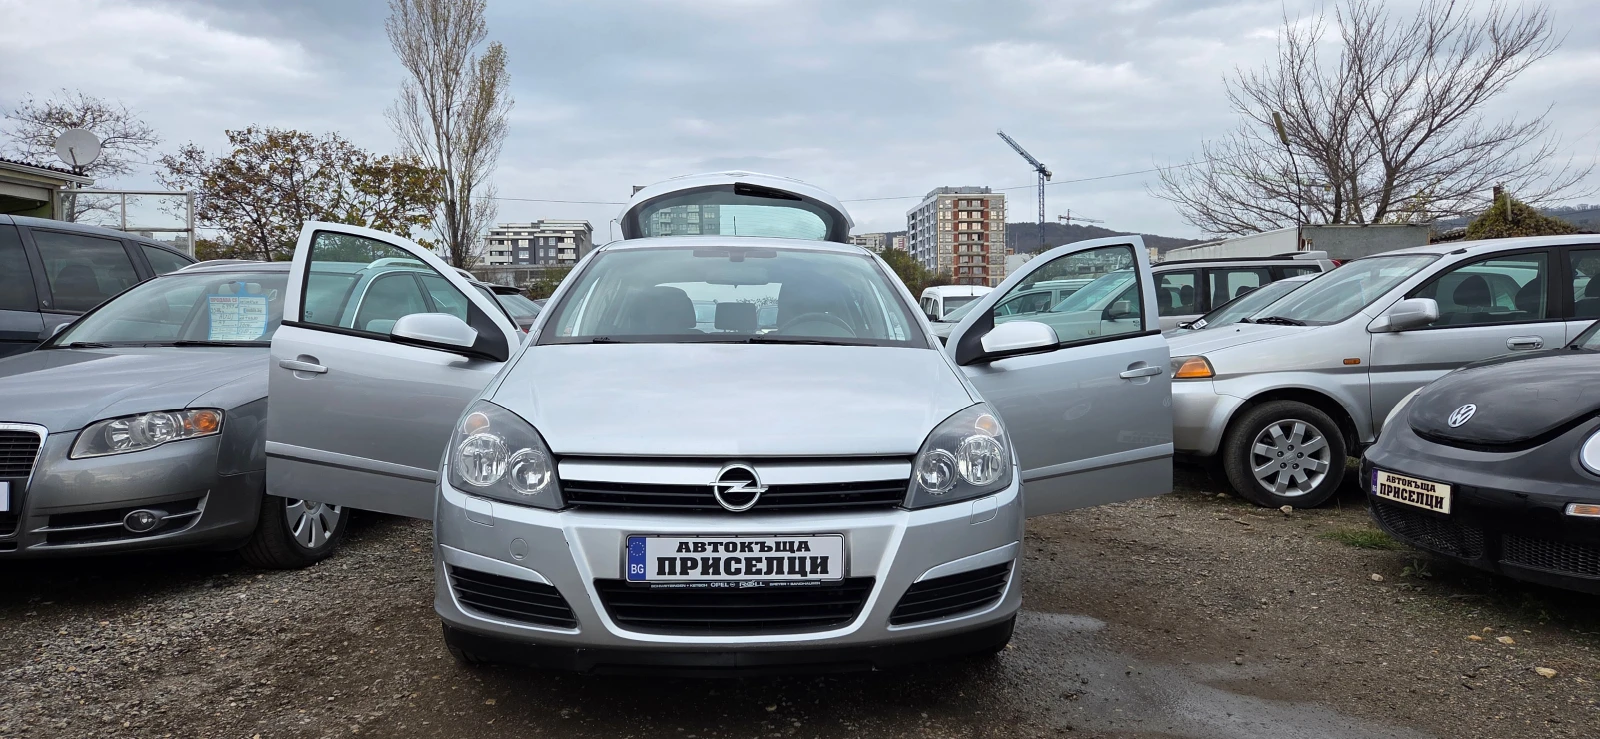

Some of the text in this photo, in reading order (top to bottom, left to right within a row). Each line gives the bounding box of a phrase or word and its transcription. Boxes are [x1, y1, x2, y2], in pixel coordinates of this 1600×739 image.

[1386, 475, 1436, 493] АВТОКЪЩА
[1379, 483, 1444, 509] ПРИСЕЛЦИ
[676, 541, 811, 553] АВТОКЪЩА
[631, 564, 644, 574] BG
[656, 556, 829, 577] ПРИСЕЛЦИ
